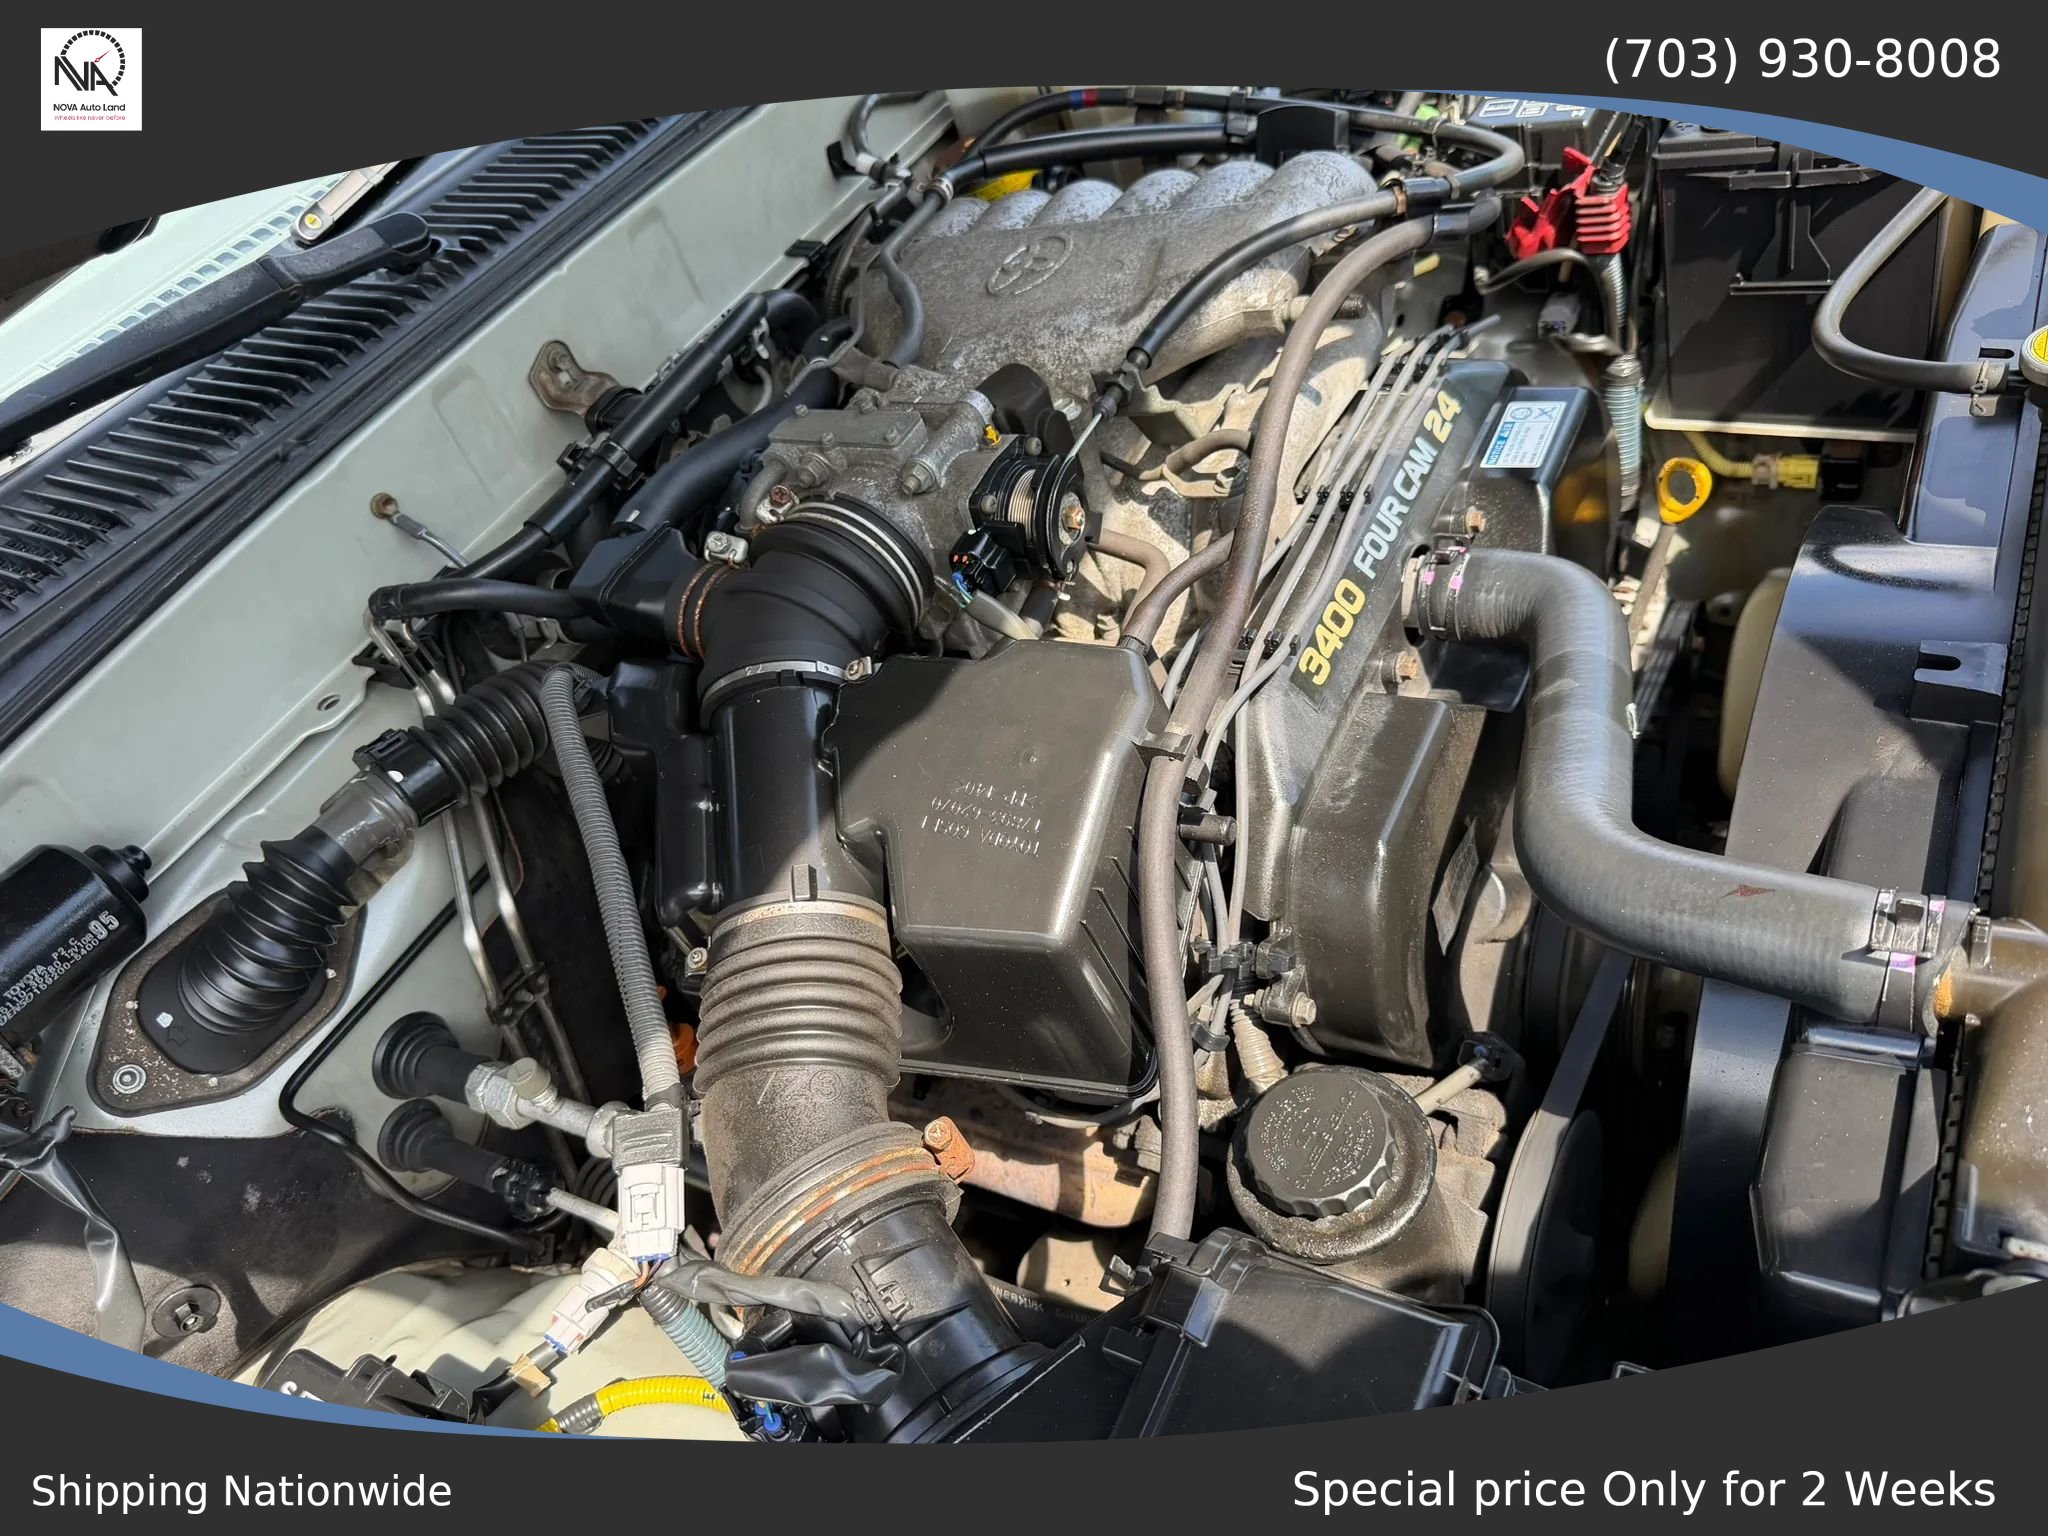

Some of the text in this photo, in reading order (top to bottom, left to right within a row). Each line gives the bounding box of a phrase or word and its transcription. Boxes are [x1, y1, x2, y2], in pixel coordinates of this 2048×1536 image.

[1299, 390, 1462, 686] 3400 FOUR CAM 24
[88, 910, 120, 940] 95
[0, 960, 62, 1018] 5110-35280
[3, 964, 47, 999] TOYOTA
[51, 946, 67, 960] P2
[0, 992, 34, 1026] DENSO
